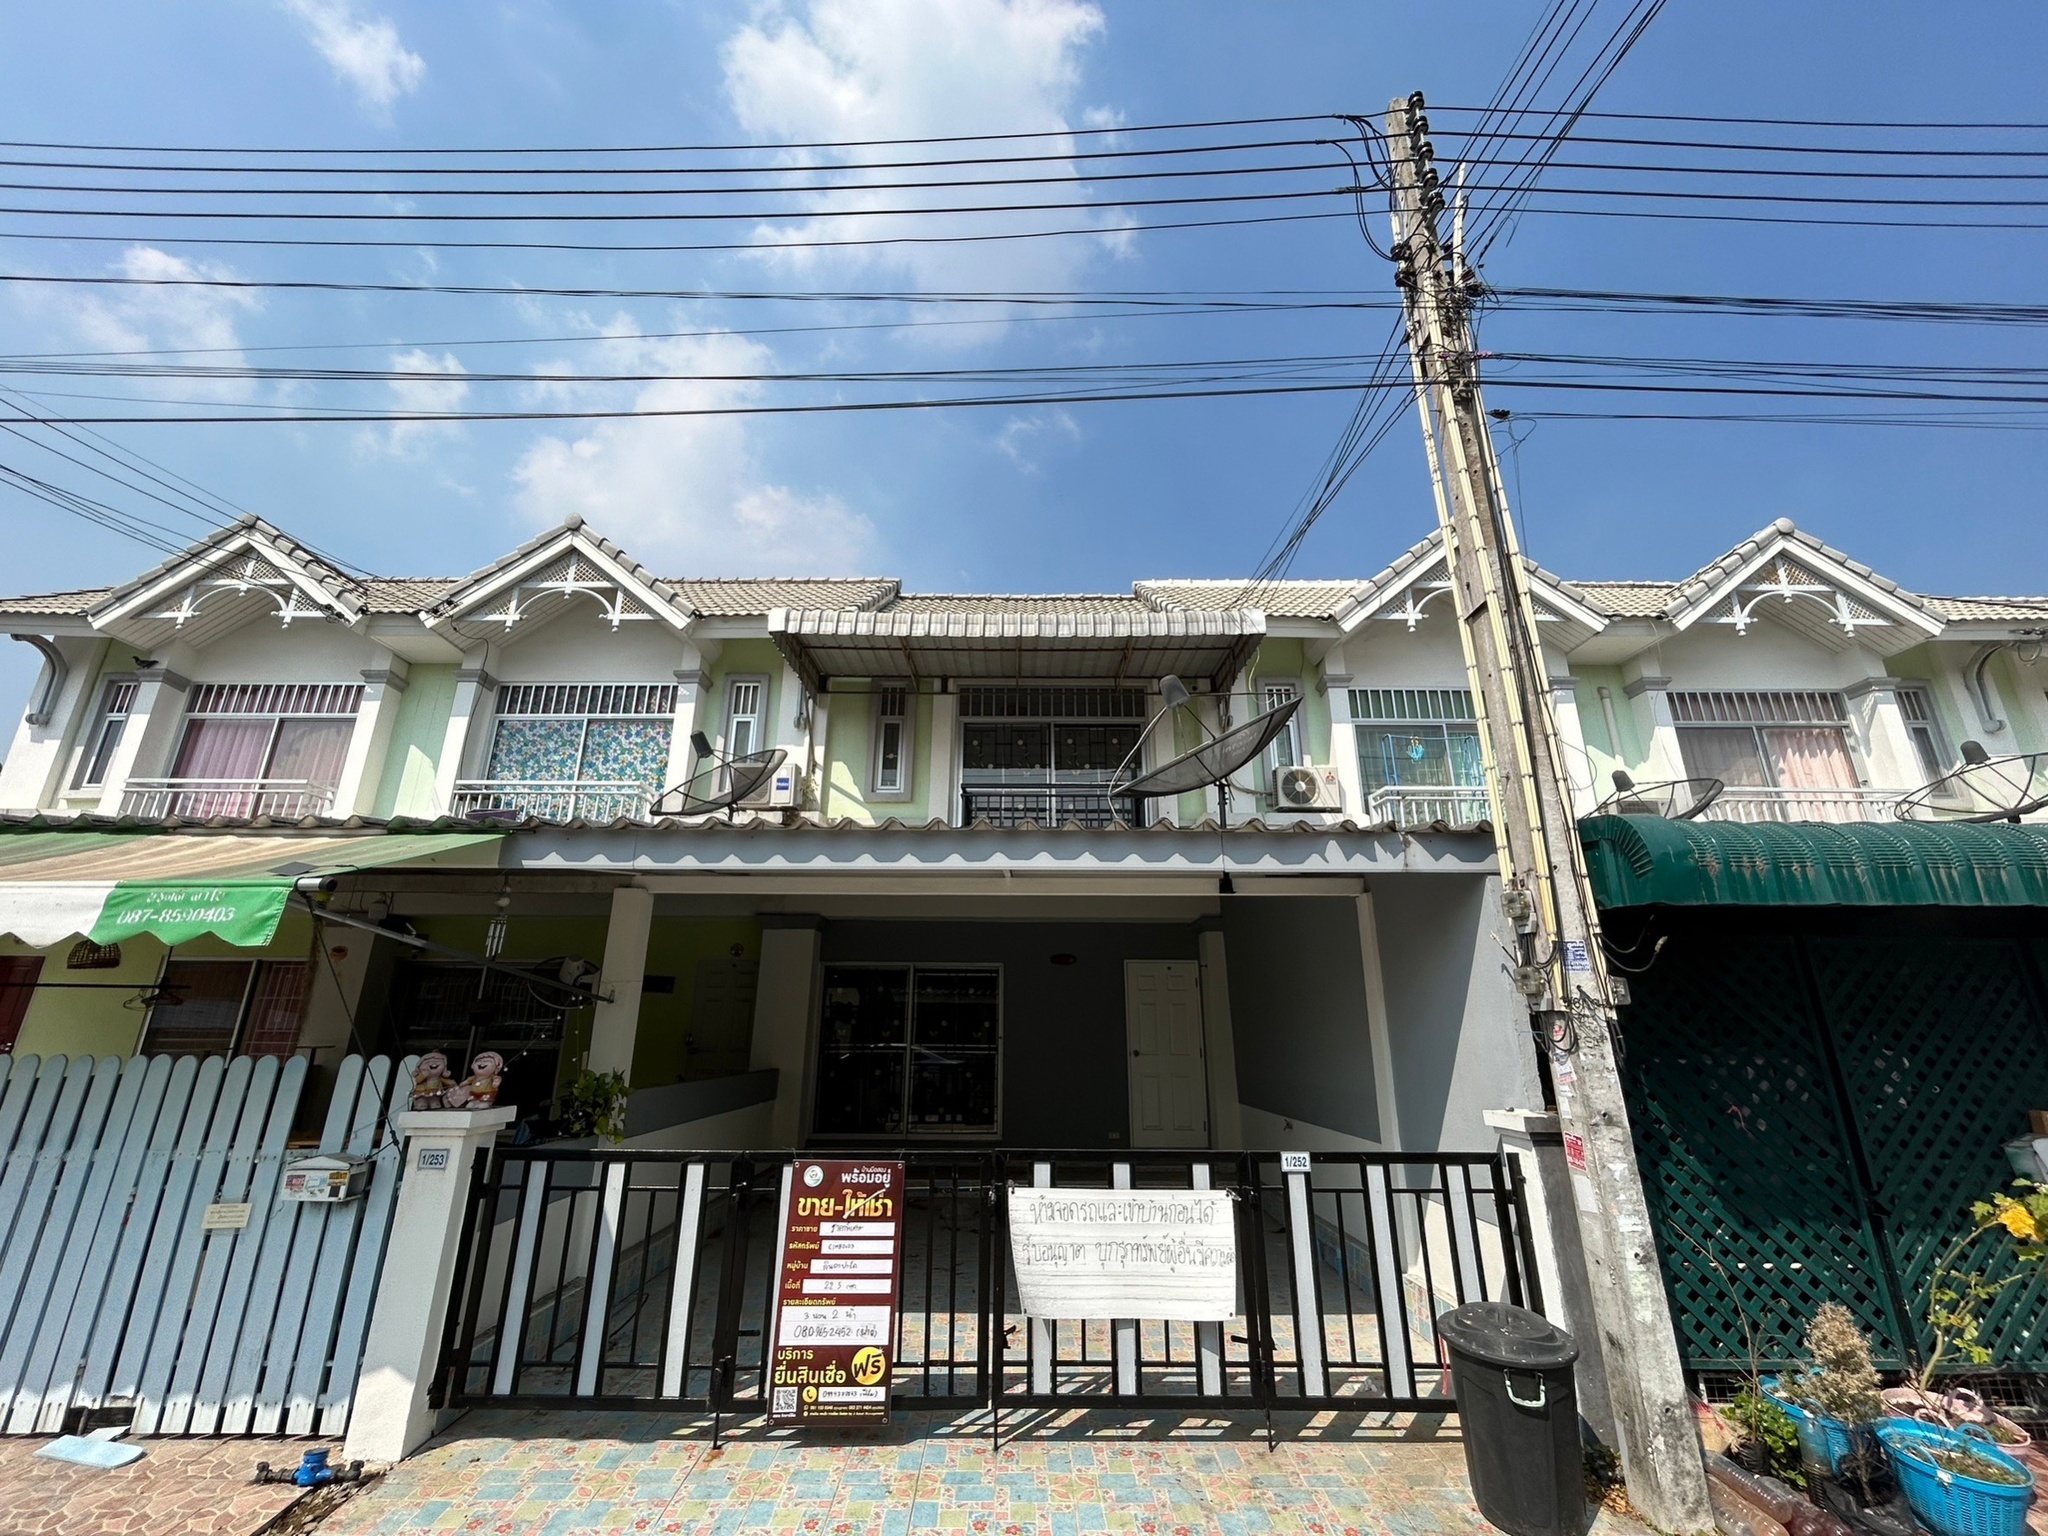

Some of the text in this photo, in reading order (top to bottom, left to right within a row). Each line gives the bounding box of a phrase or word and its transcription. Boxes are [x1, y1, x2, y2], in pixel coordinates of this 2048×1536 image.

[422, 1154, 445, 1166] 1/253
[1285, 1156, 1308, 1168] 1/252
[841, 1167, 891, 1188] พร้อมอยู่
[832, 1309, 839, 1319] 2
[777, 1347, 814, 1360] บริการ
[774, 1360, 847, 1384] ยื่นสินเชื่อ
[853, 1353, 882, 1378] ฟรี
